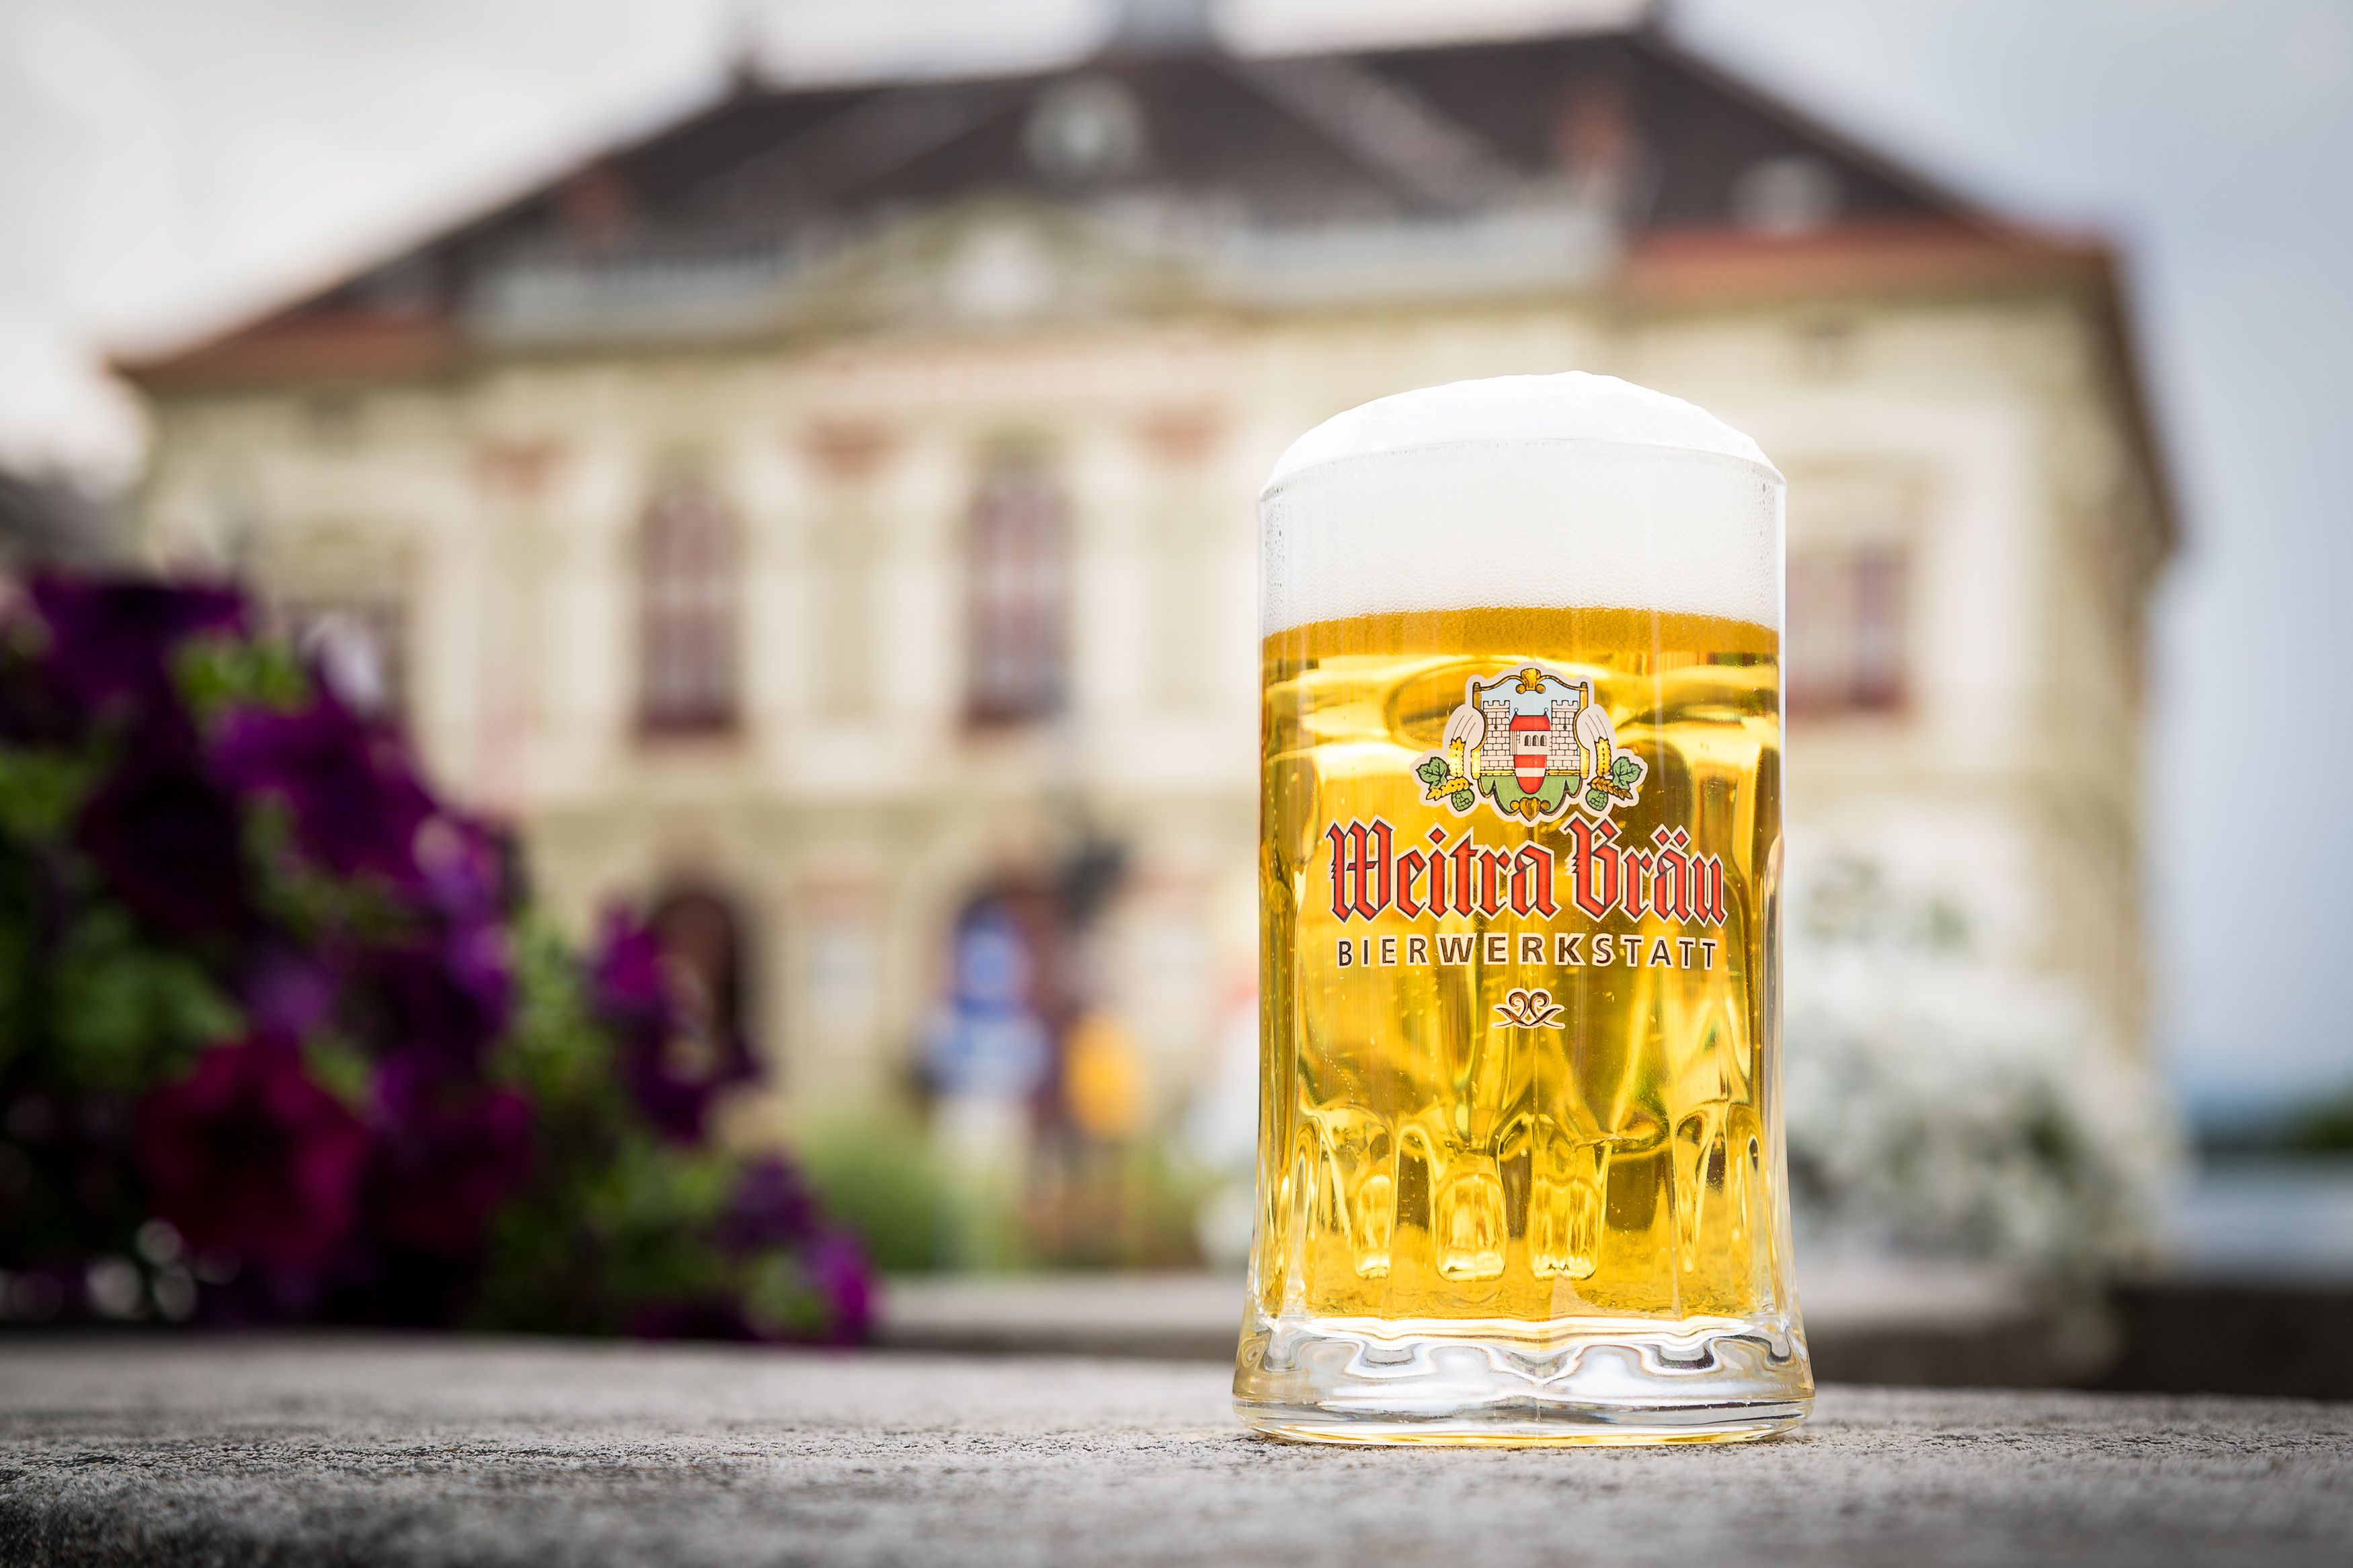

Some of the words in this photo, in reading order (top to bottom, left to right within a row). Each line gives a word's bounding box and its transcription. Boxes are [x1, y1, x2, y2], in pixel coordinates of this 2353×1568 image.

[1326, 816, 1561, 923] Weitra
[1562, 816, 1727, 927] Bräu
[1337, 934, 1717, 969] BIERWERKSTATT
